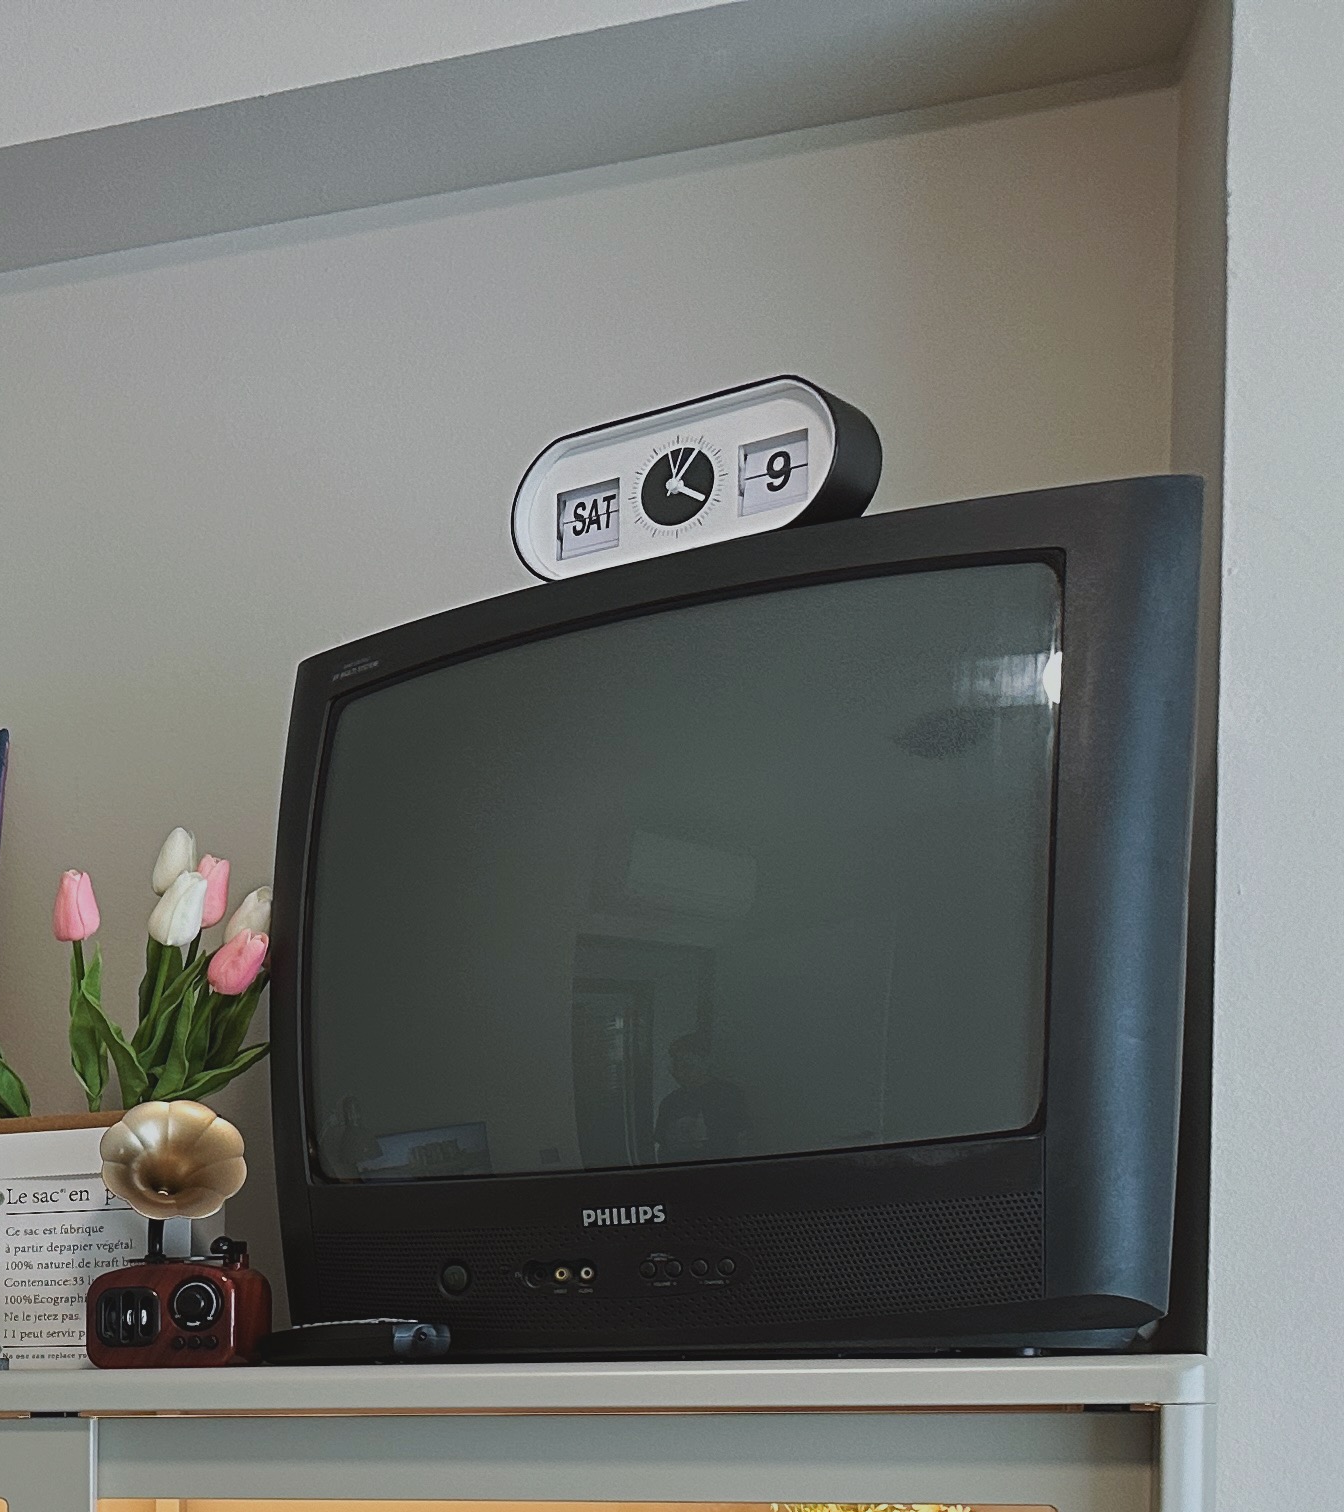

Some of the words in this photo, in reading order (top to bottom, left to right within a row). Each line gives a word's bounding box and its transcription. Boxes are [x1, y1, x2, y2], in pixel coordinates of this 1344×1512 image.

[765, 450, 792, 493] 9
[572, 493, 617, 537] SAT
[6, 1188, 27, 1205] Le
[68, 1189, 90, 1203] en
[582, 1204, 666, 1227] PHILIPS
[23, 1227, 39, 1235] sac
[42, 1225, 57, 1235] est
[59, 1223, 105, 1237] fabrique
[13, 1243, 44, 1256] partir
[5, 1260, 34, 1271] 100%
[94, 1256, 119, 1269] kraft
[4, 1312, 19, 1322] Ne
[22, 1312, 32, 1321] le
[34, 1313, 59, 1324] jetez
[61, 1313, 80, 1324] pas
[20, 1329, 43, 1341] peut
[47, 1328, 76, 1339] servir
